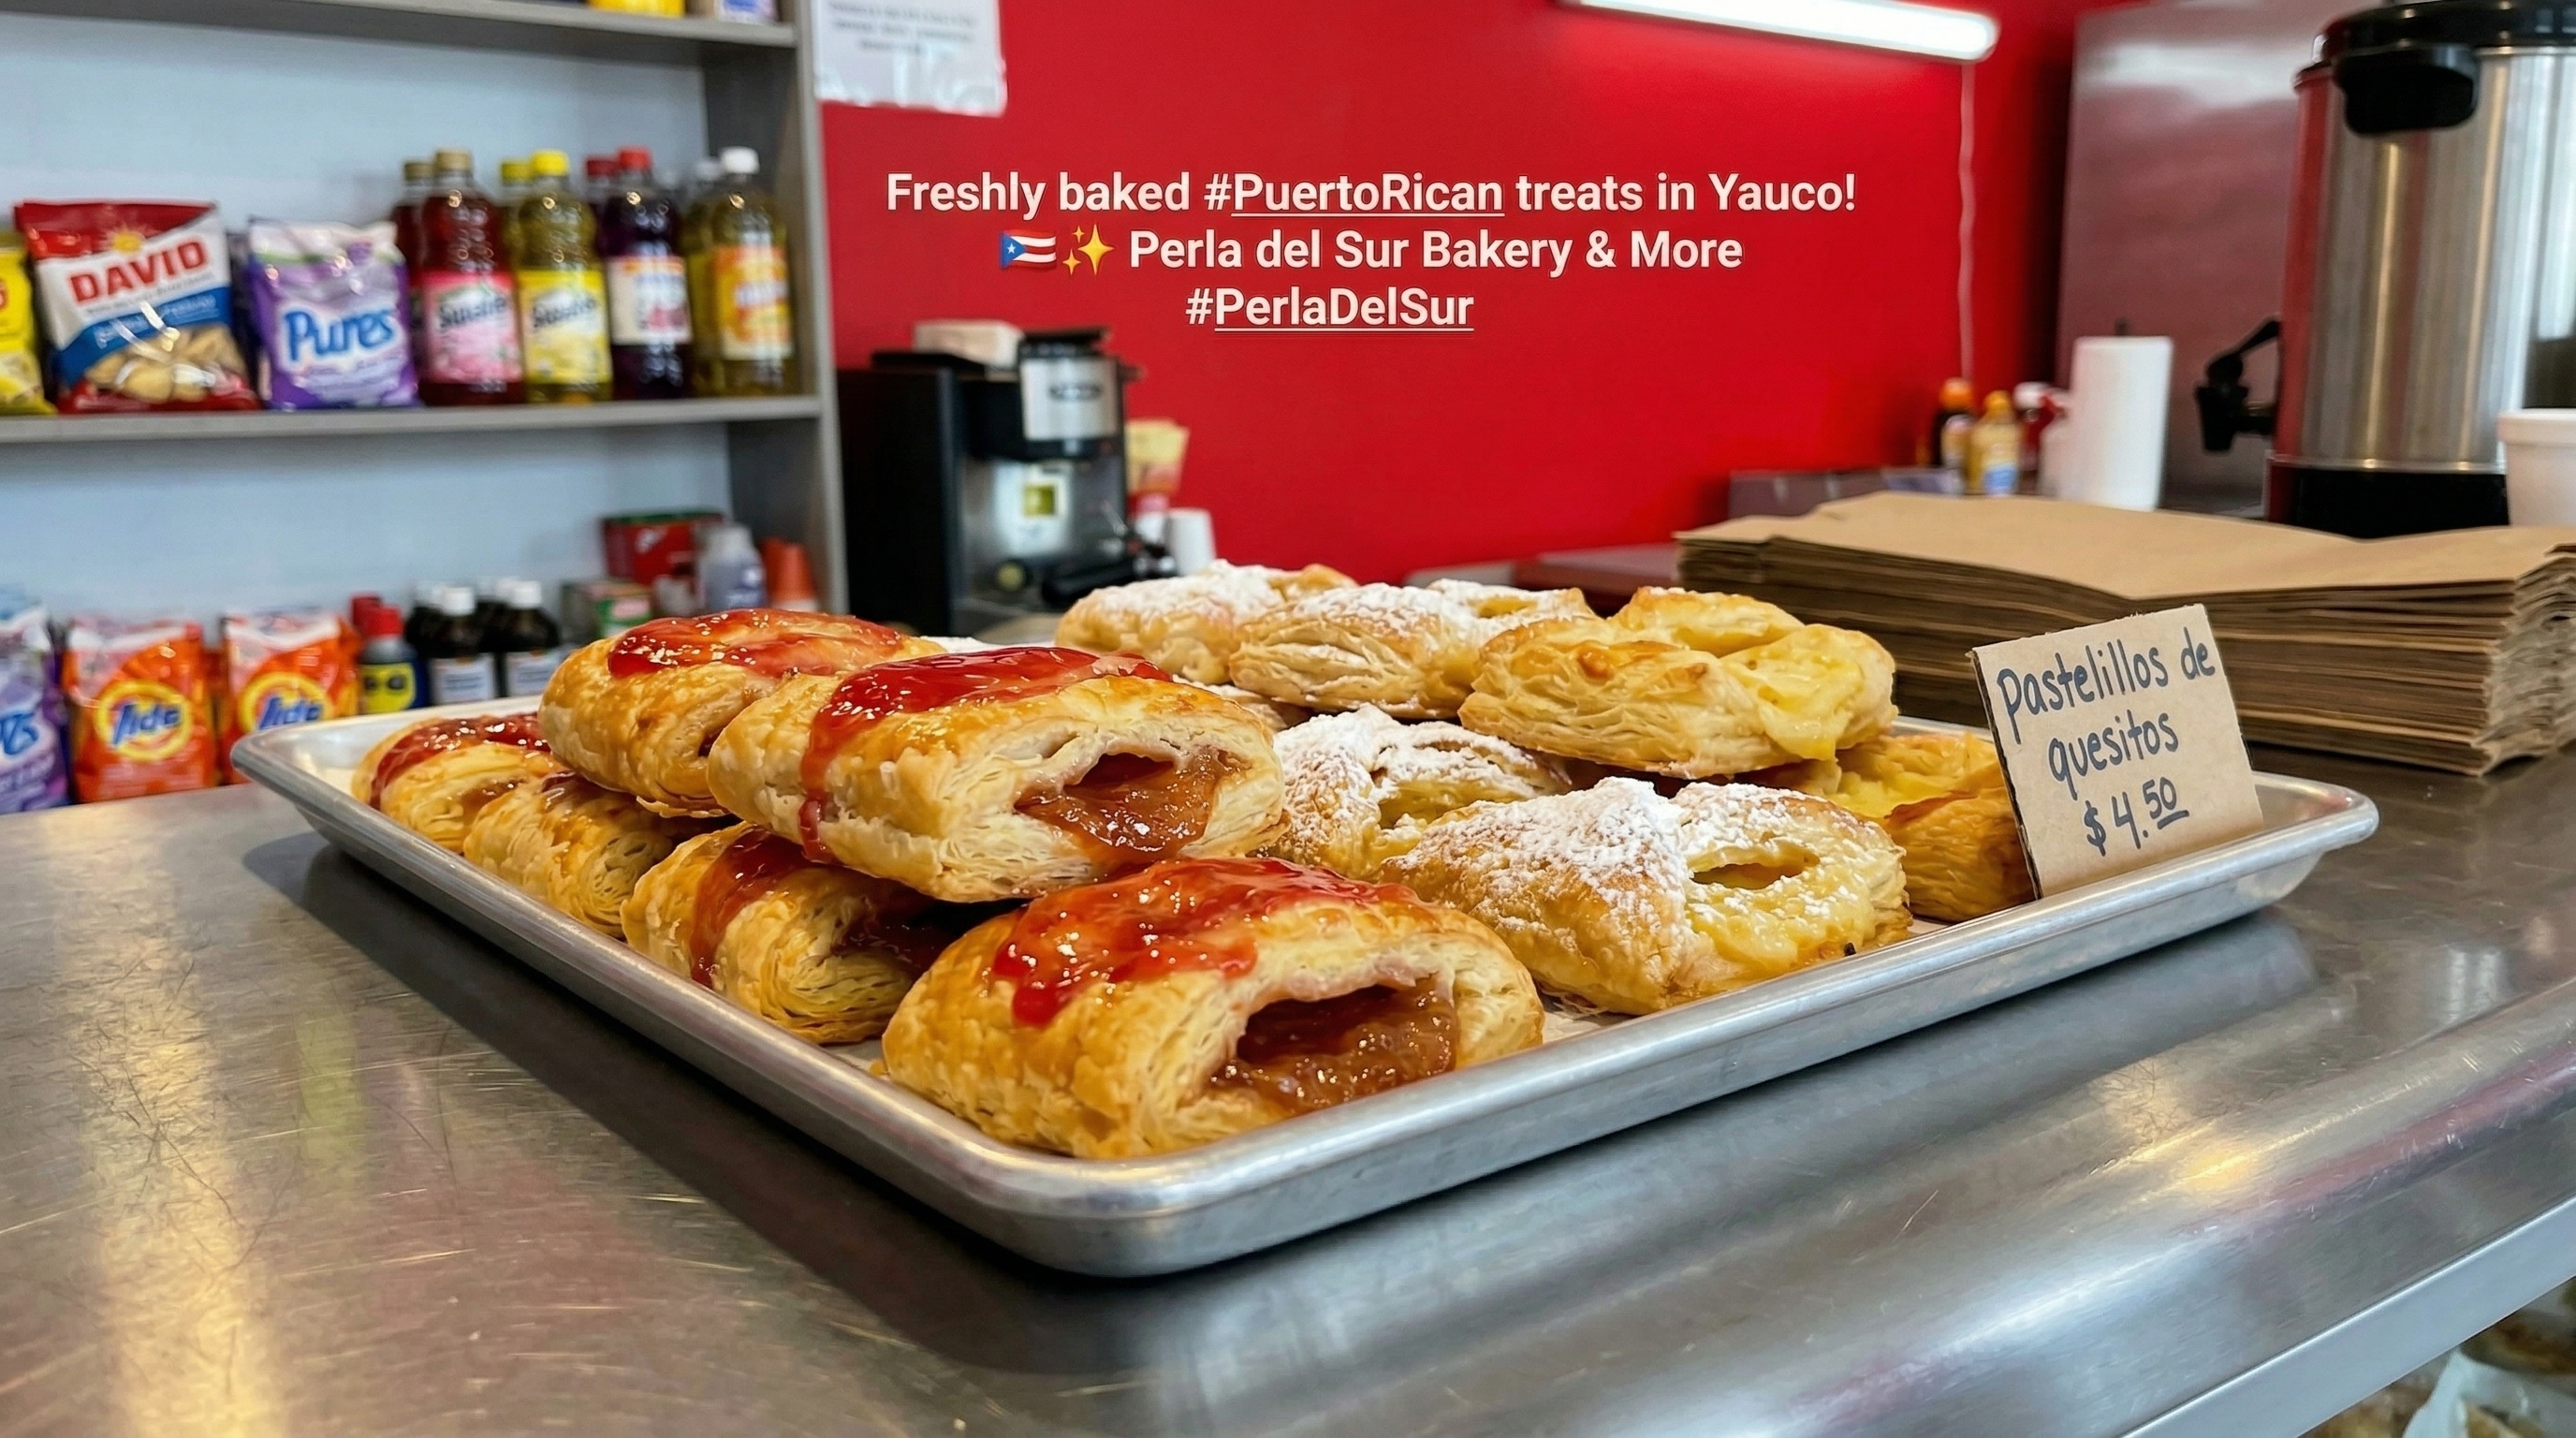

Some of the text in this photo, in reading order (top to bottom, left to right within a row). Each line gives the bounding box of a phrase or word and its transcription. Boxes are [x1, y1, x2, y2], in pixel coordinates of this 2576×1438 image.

[70, 242, 206, 302] DAVID
[285, 308, 393, 361] Pures
[2180, 626, 2217, 681] de
[2048, 710, 2180, 801] quesitos
